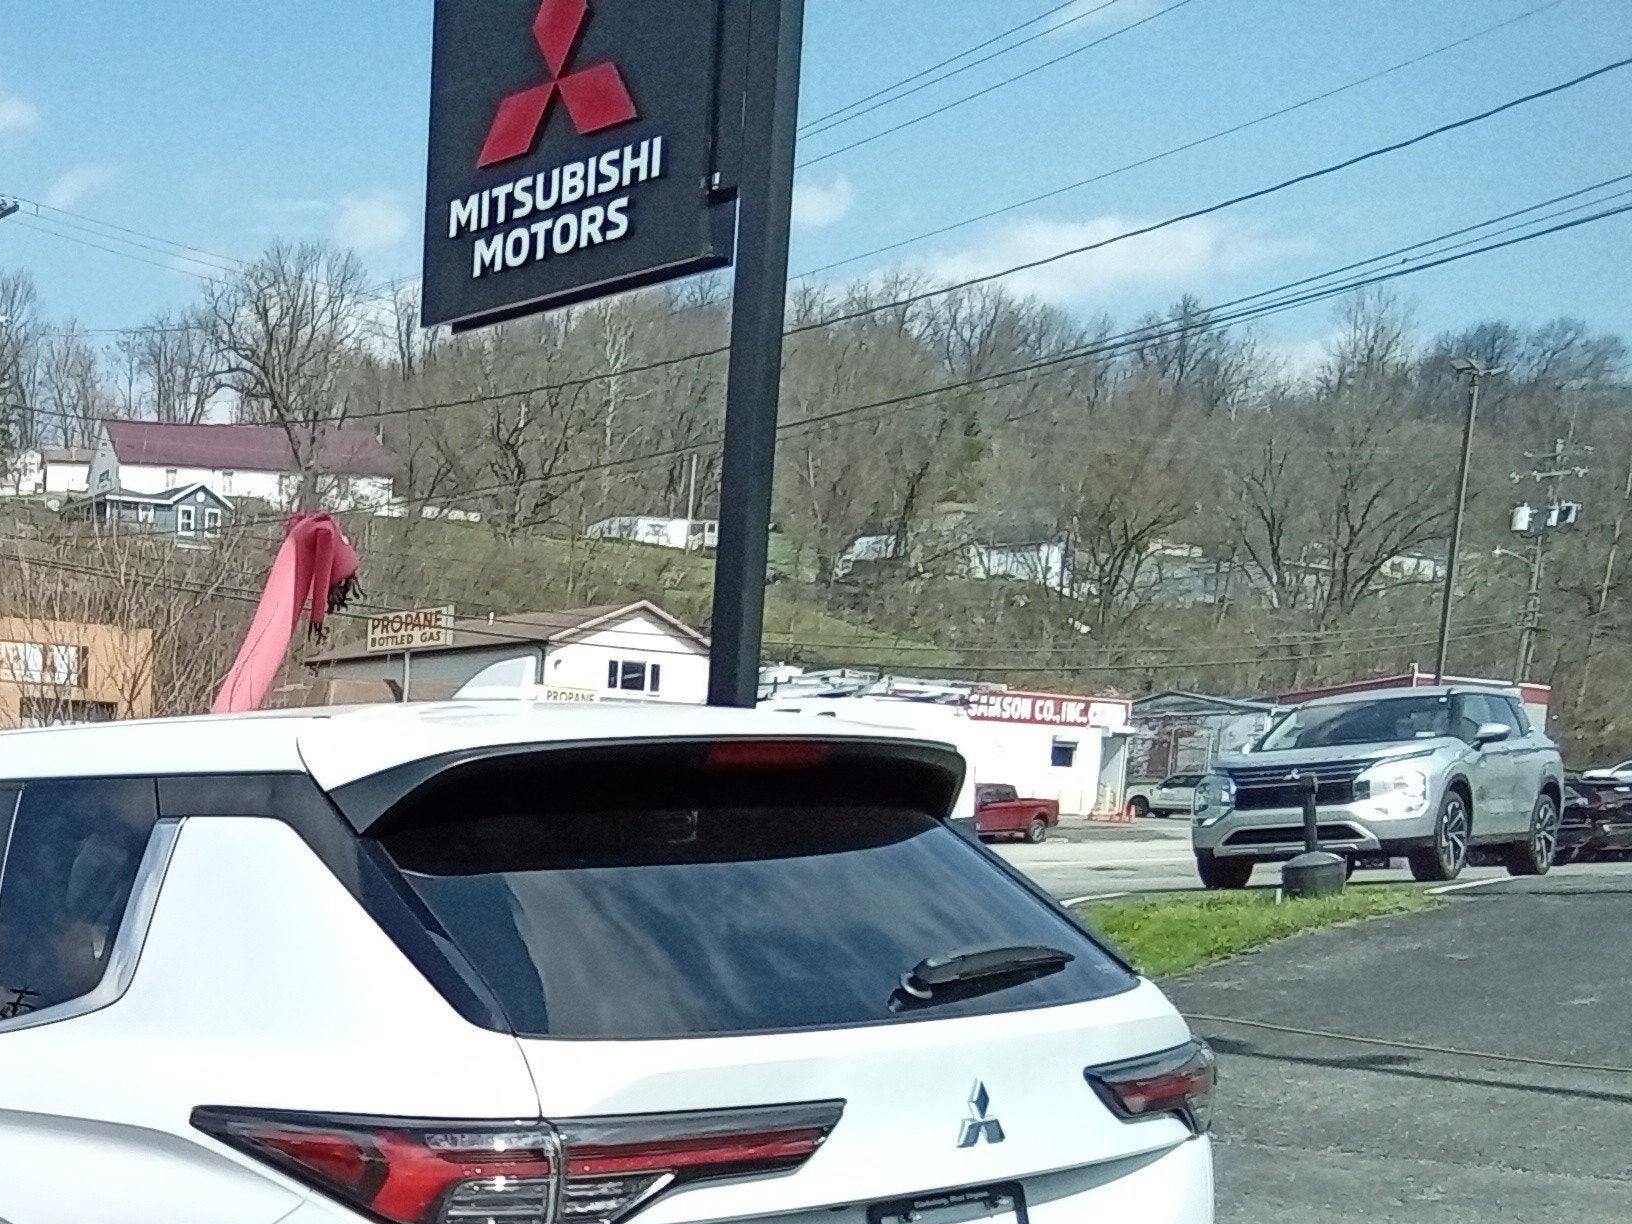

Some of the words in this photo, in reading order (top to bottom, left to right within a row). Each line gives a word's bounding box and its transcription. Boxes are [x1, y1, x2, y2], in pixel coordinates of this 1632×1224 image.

[448, 136, 662, 238] MITSUBISHI
[472, 197, 630, 278] MOTORS
[370, 633, 414, 648] BOTTLED
[420, 631, 442, 643] GAS
[371, 610, 443, 635] PROPANE
